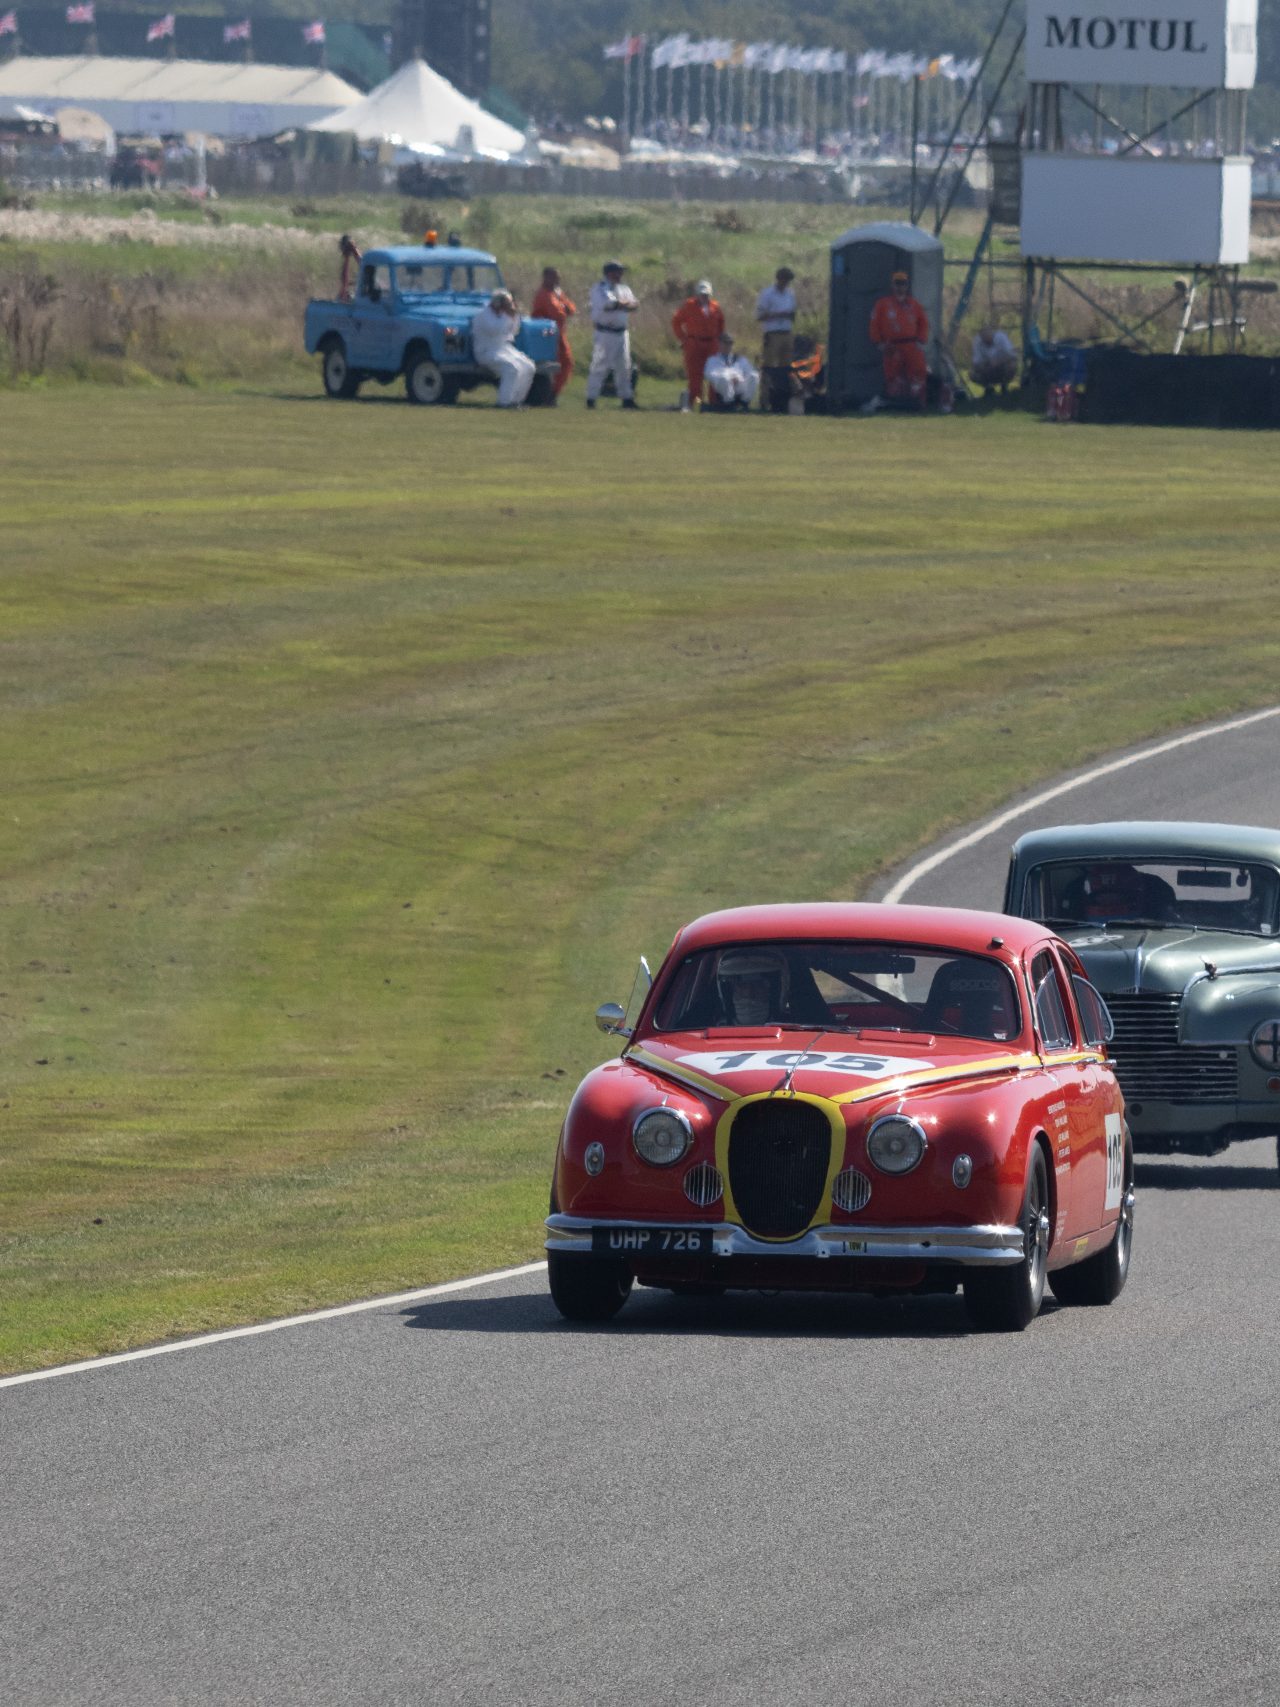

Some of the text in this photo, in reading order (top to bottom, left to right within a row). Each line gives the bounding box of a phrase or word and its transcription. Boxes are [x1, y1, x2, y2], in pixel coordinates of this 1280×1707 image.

[1045, 16, 1208, 53] MOTUL
[715, 1052, 888, 1072] 105
[1108, 1133, 1122, 1190] 105
[609, 1229, 701, 1250] UHP 726
